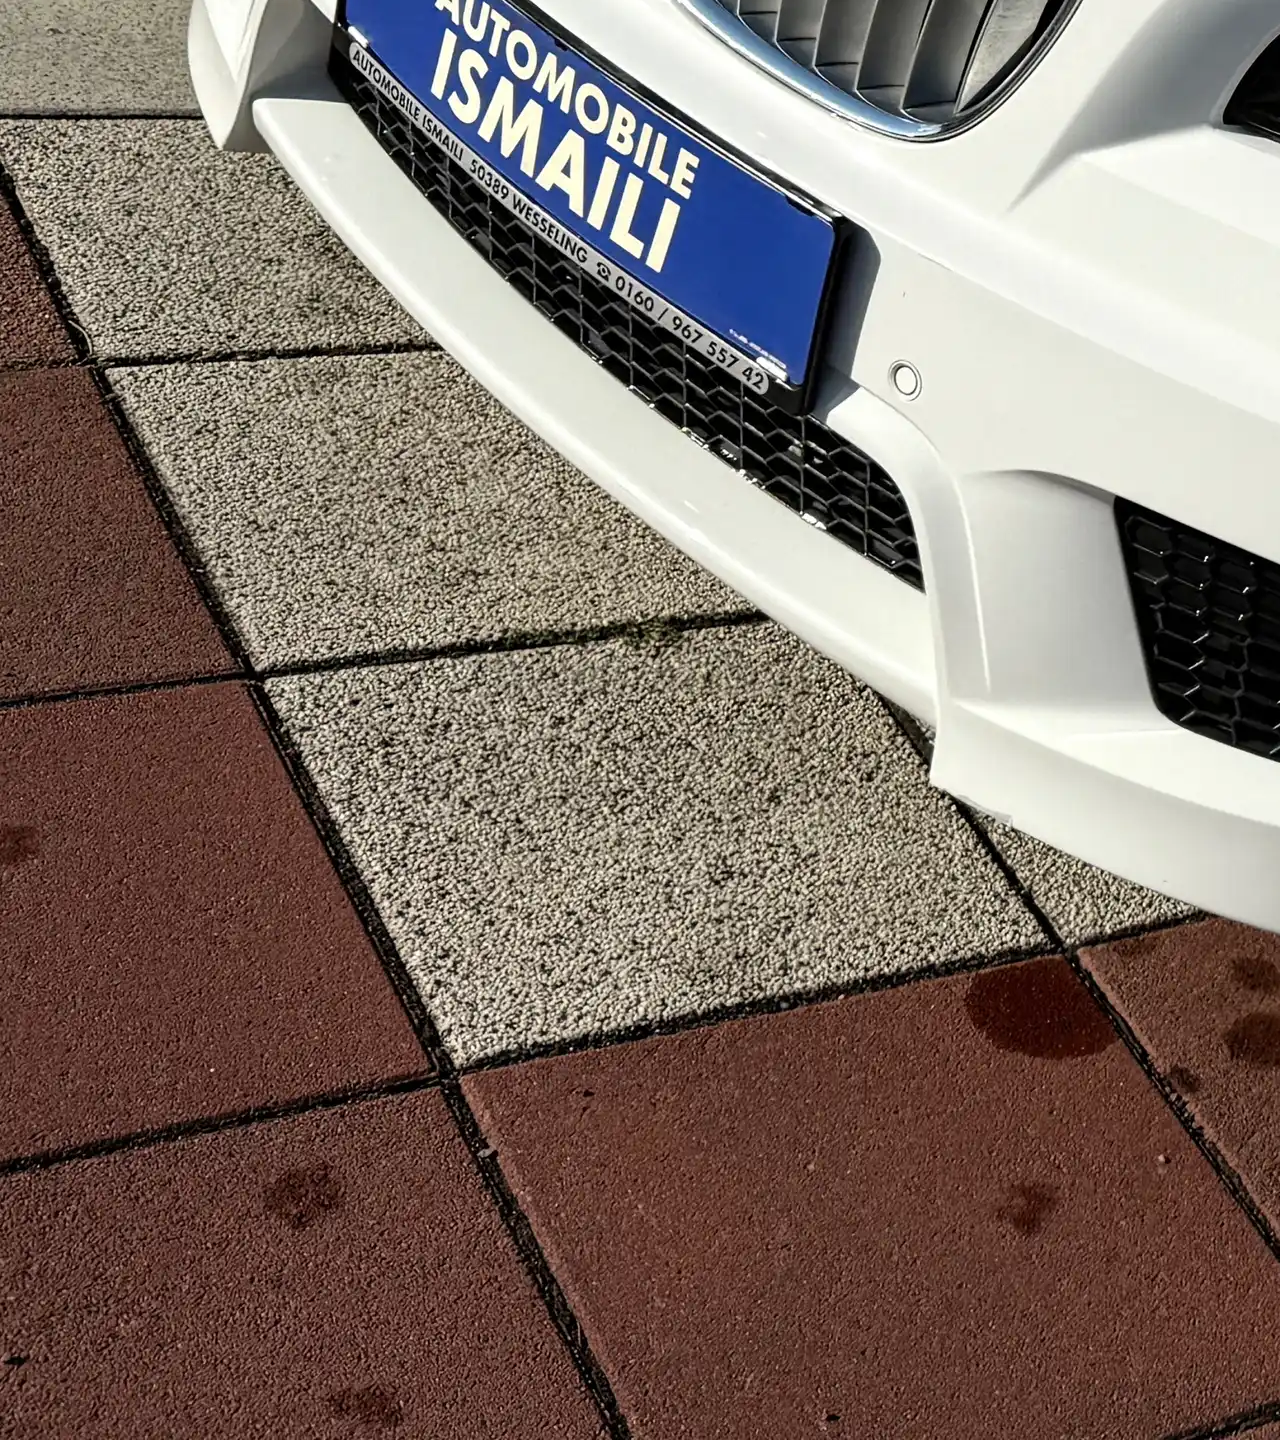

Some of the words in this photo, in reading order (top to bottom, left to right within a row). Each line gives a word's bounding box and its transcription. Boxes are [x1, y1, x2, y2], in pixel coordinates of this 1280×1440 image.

[352, 49, 421, 121] AUTOMOBILE
[422, 114, 464, 162] ISMAILI
[469, 159, 510, 200] 50389
[511, 194, 589, 264] WESSELING
[615, 275, 654, 313] 0160
[671, 316, 703, 345] 967
[706, 343, 740, 370] 557
[741, 366, 764, 391] 42
[430, 28, 681, 273] ISMAILI
